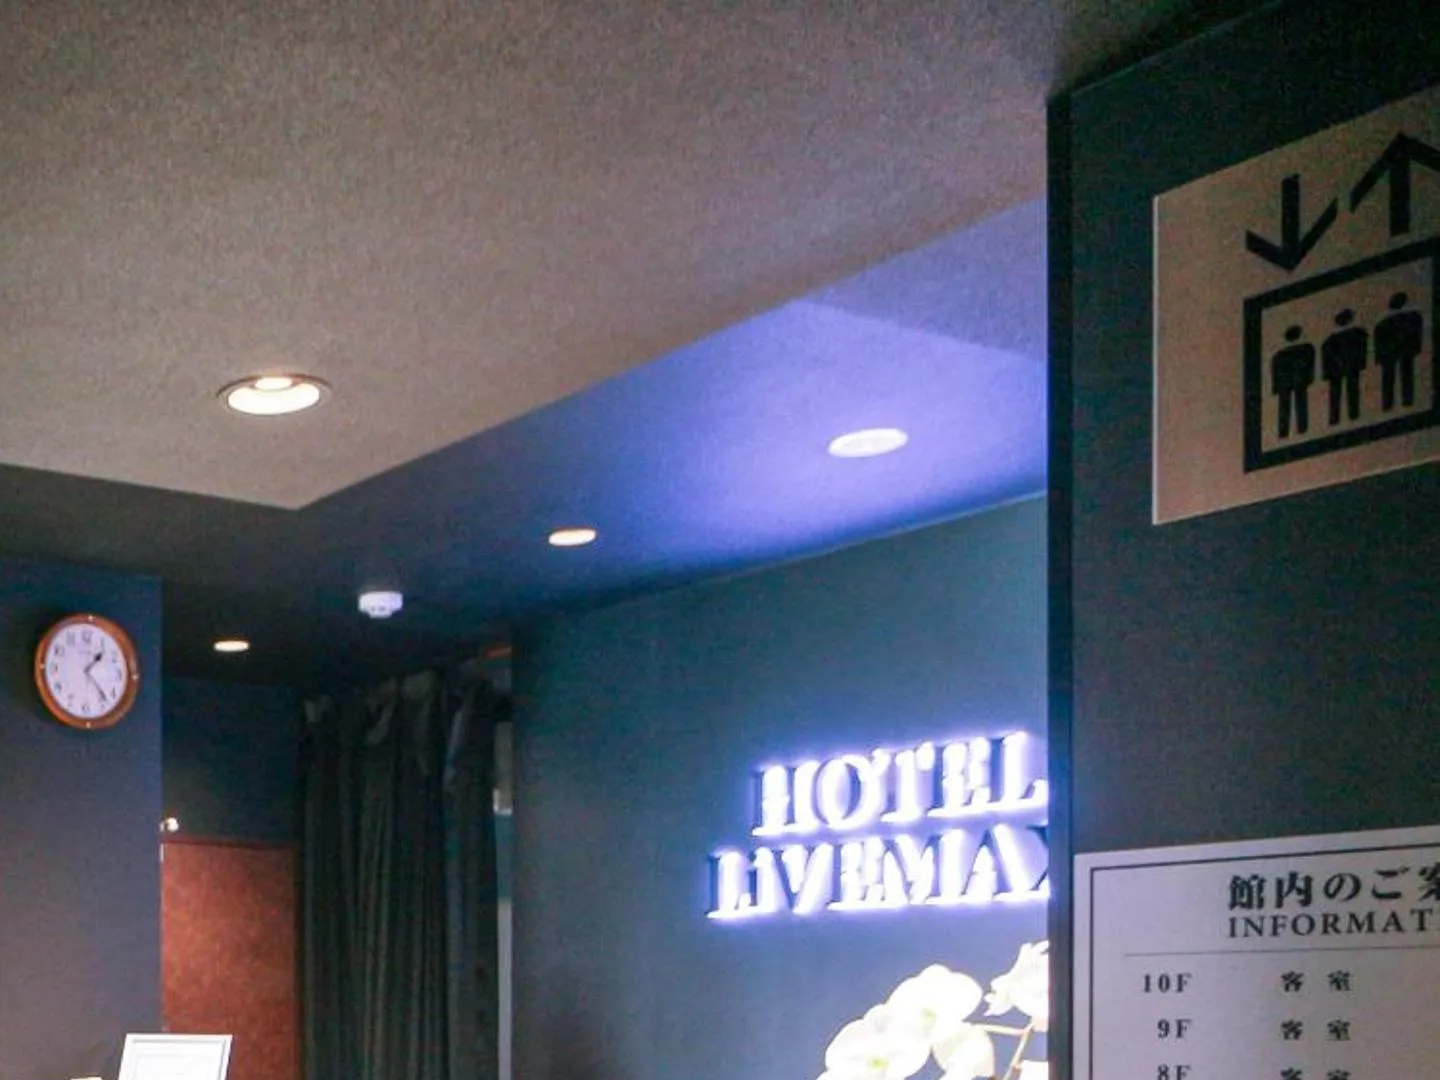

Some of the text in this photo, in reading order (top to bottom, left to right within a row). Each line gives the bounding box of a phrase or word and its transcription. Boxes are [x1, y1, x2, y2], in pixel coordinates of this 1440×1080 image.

[751, 731, 1049, 836] HOTEL
[1144, 973, 1191, 993] 10F
[1157, 1018, 1191, 1039] 9F
